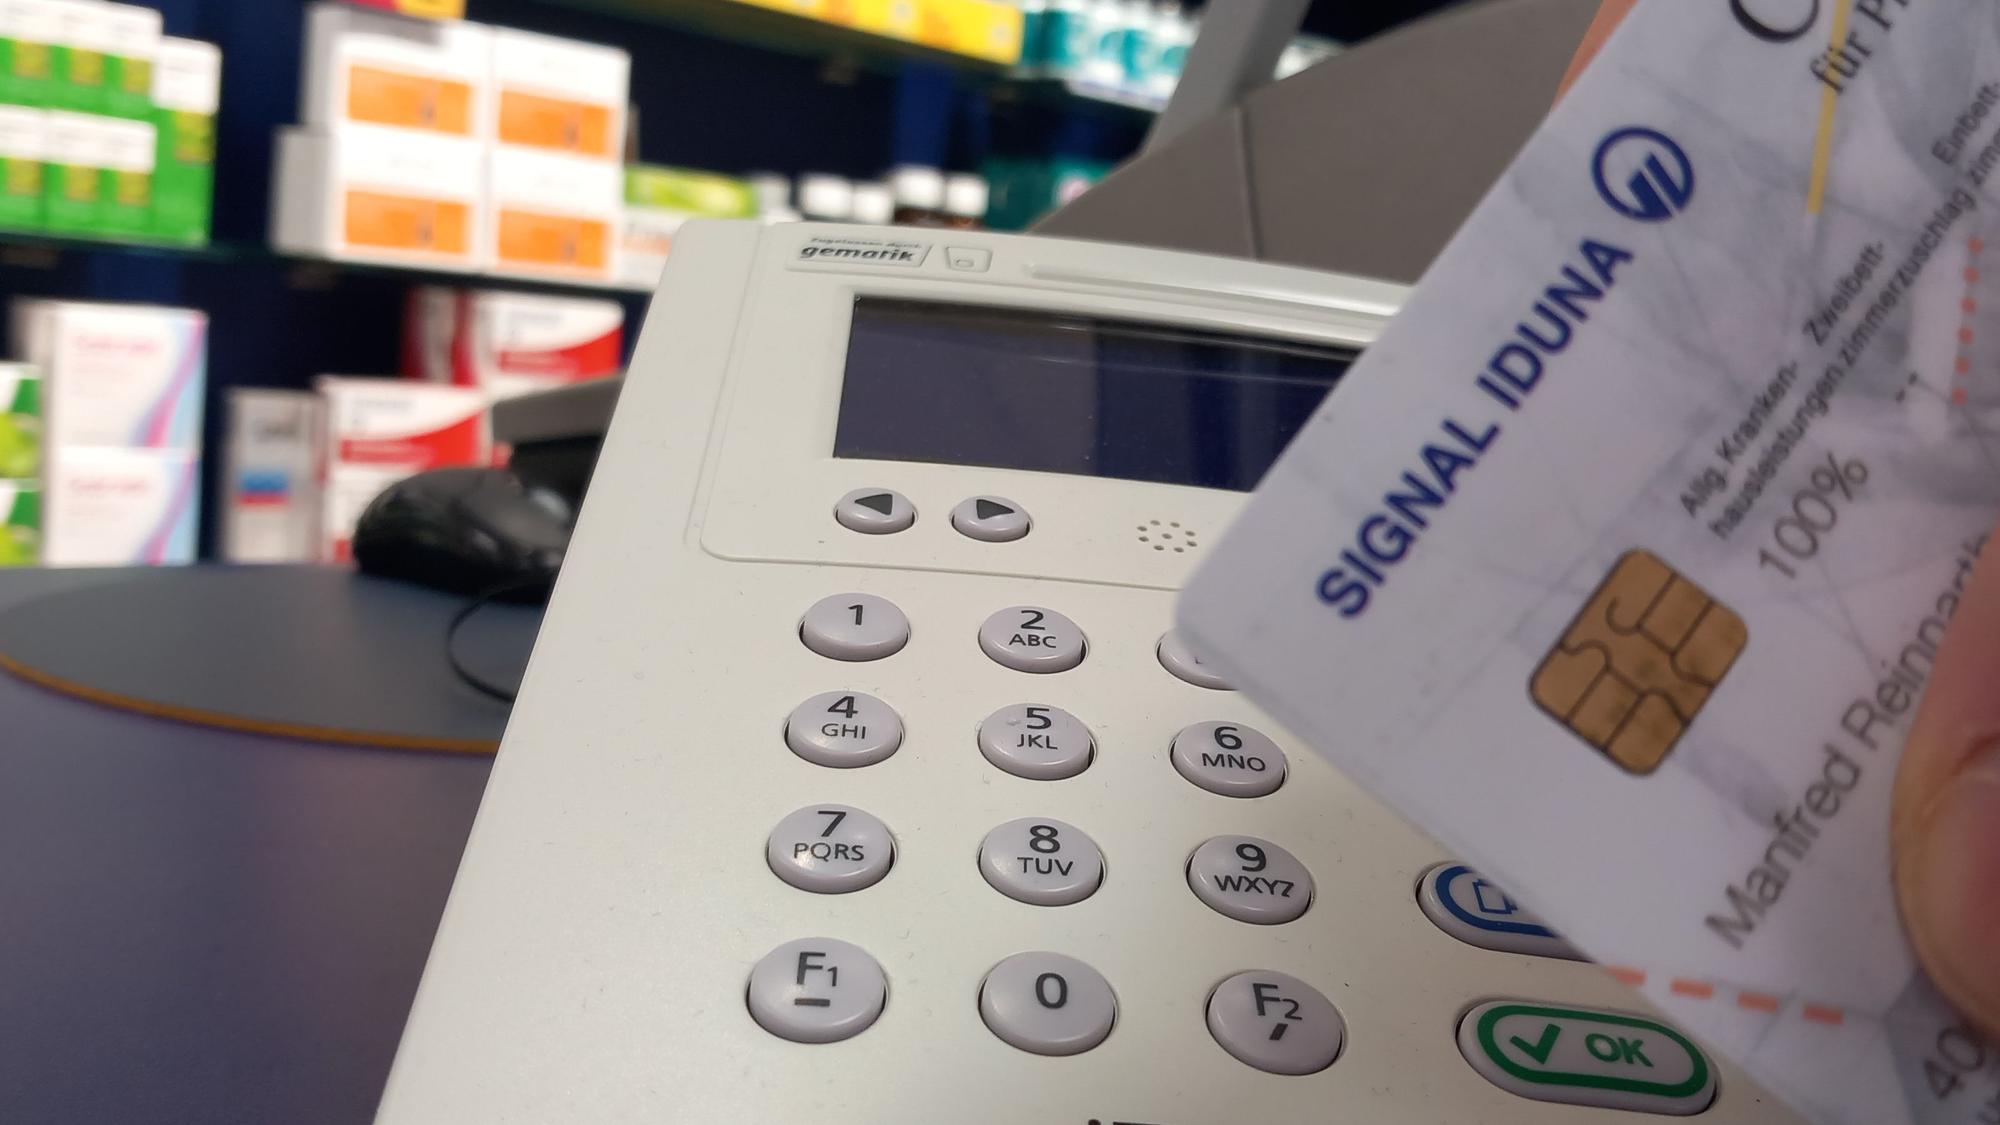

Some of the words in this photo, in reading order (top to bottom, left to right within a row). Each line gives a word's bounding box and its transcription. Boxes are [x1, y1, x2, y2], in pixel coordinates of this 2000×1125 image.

[1810, 32, 1873, 94] für
[1838, 188, 1977, 367] zimmerzuschlag
[1803, 241, 1884, 347] Zweibett-
[1316, 418, 1502, 619] SIGNAL
[1476, 237, 1635, 411] IDUNA
[1708, 362, 1845, 541] hausleistungen
[1760, 451, 1869, 580] 100%
[848, 604, 864, 626] 1
[1020, 610, 1046, 630] 2
[1008, 633, 1058, 649] ABC
[827, 695, 859, 719] 4
[1026, 707, 1053, 730] 5
[821, 722, 867, 740] GHI
[1016, 732, 1059, 750] JKL
[1213, 726, 1244, 750] 6
[1201, 752, 1267, 772] MNO
[817, 811, 848, 838] 7
[793, 842, 865, 863] PQRS
[1029, 825, 1061, 854] 8
[1705, 743, 1862, 951] Manfred
[1017, 856, 1074, 877] TUV
[1235, 843, 1267, 873] 9
[1214, 874, 1295, 898] WXYZ
[796, 951, 839, 987] F1
[1035, 972, 1068, 1009] 0
[1252, 982, 1304, 1021] F2
[1584, 1032, 1655, 1068] OK
